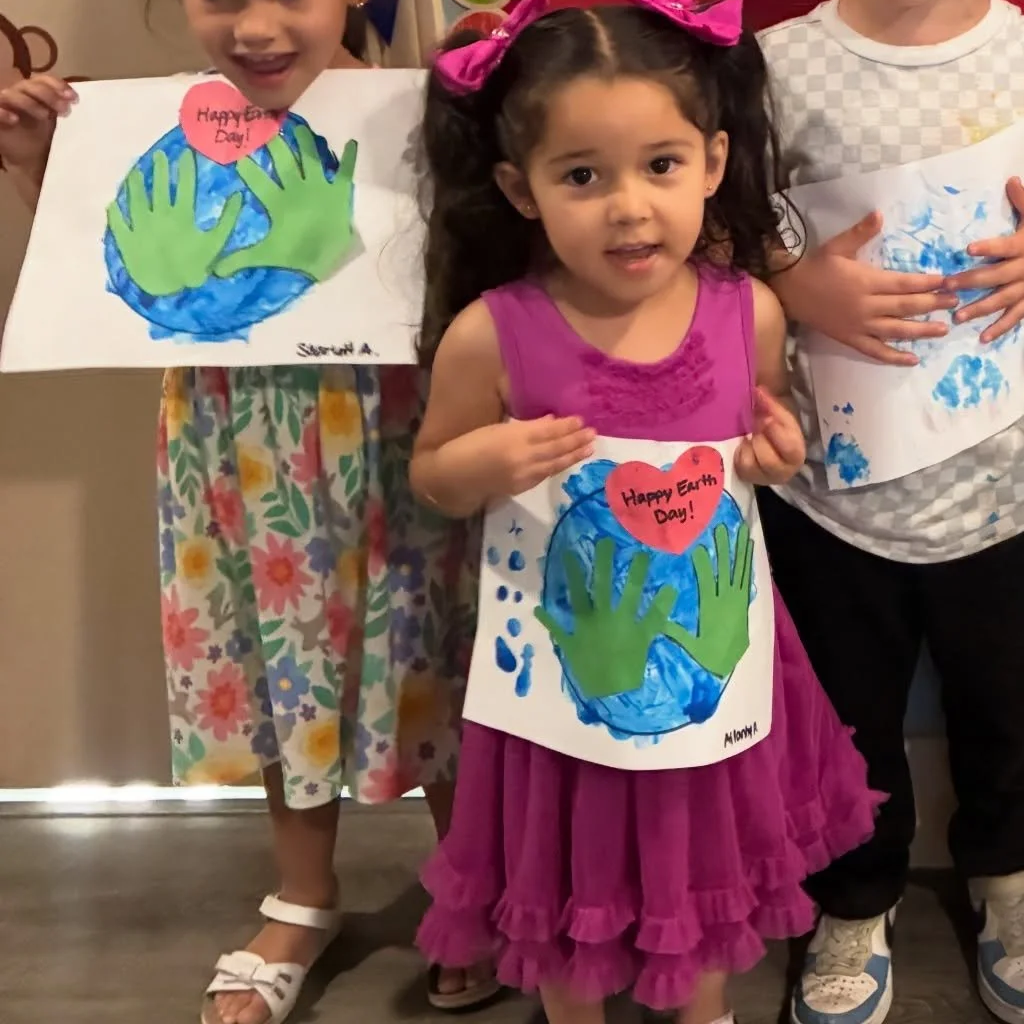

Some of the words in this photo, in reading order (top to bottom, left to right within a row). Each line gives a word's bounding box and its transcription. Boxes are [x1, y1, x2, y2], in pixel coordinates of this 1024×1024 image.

[197, 107, 240, 129] Happy
[621, 487, 673, 508] Happy
[676, 474, 718, 497] Earth
[653, 500, 694, 525] Day!
